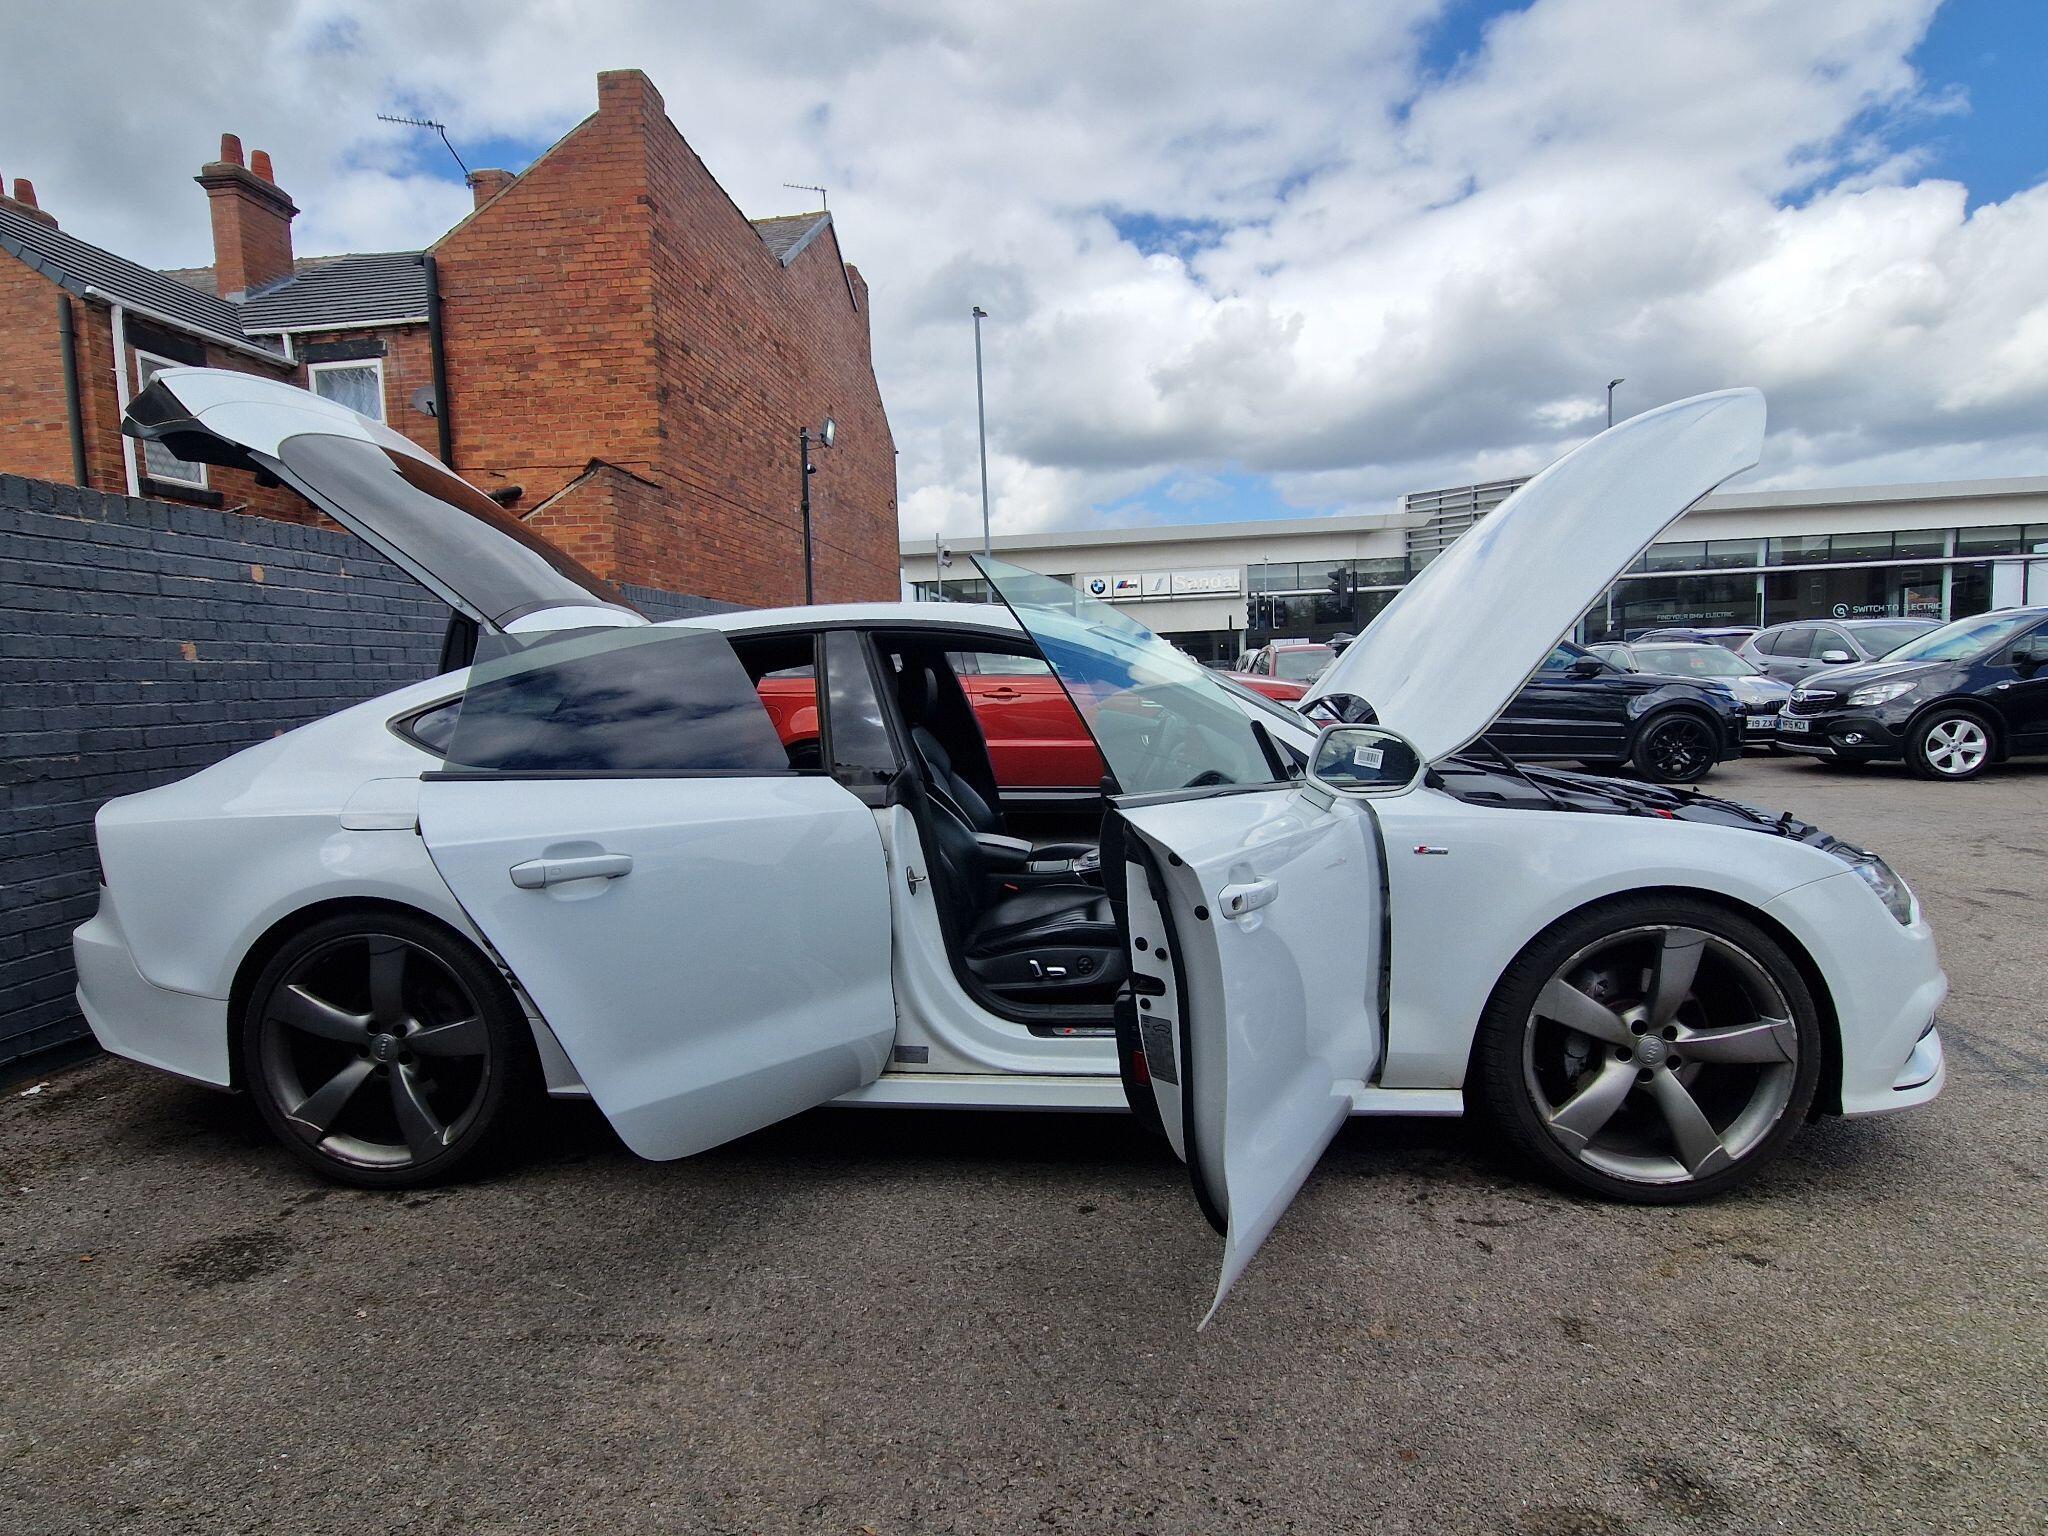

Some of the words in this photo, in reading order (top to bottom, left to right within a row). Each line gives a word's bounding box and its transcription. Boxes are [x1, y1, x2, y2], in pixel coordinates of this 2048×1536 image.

[1174, 572, 1238, 591] Sandal
[1852, 604, 1885, 614] SWITCH
[1886, 603, 1899, 611] TO
